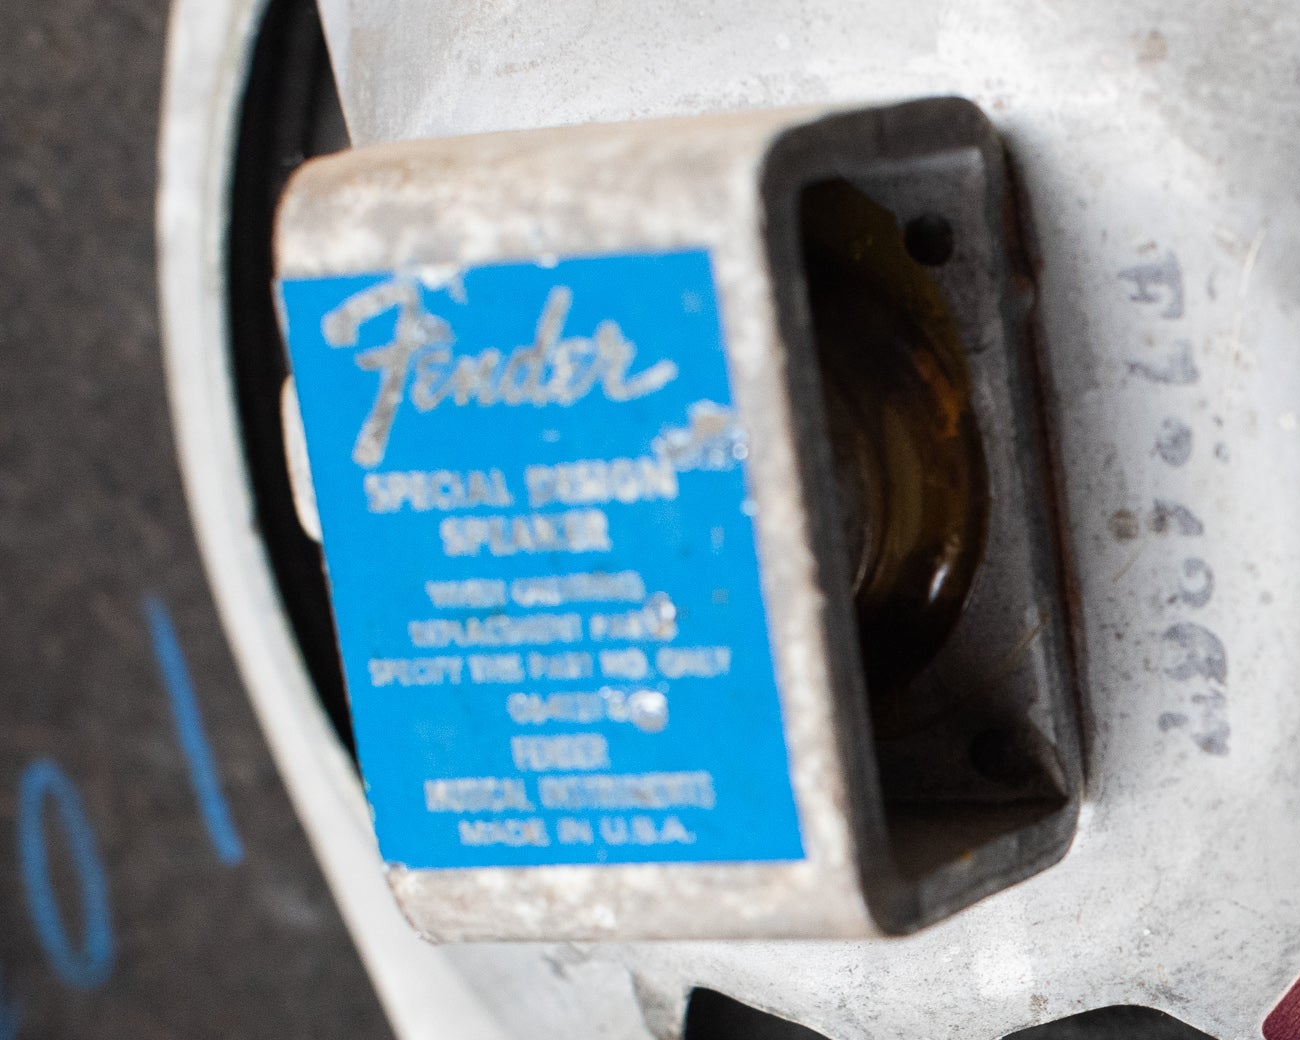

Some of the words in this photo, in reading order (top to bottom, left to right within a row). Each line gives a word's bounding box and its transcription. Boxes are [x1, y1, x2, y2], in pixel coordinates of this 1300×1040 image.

[323, 282, 679, 468] Fender
[362, 467, 512, 512] SPECIAL
[440, 508, 611, 556] SPEAKER
[458, 818, 549, 846] MADE
[558, 818, 593, 844] IN
